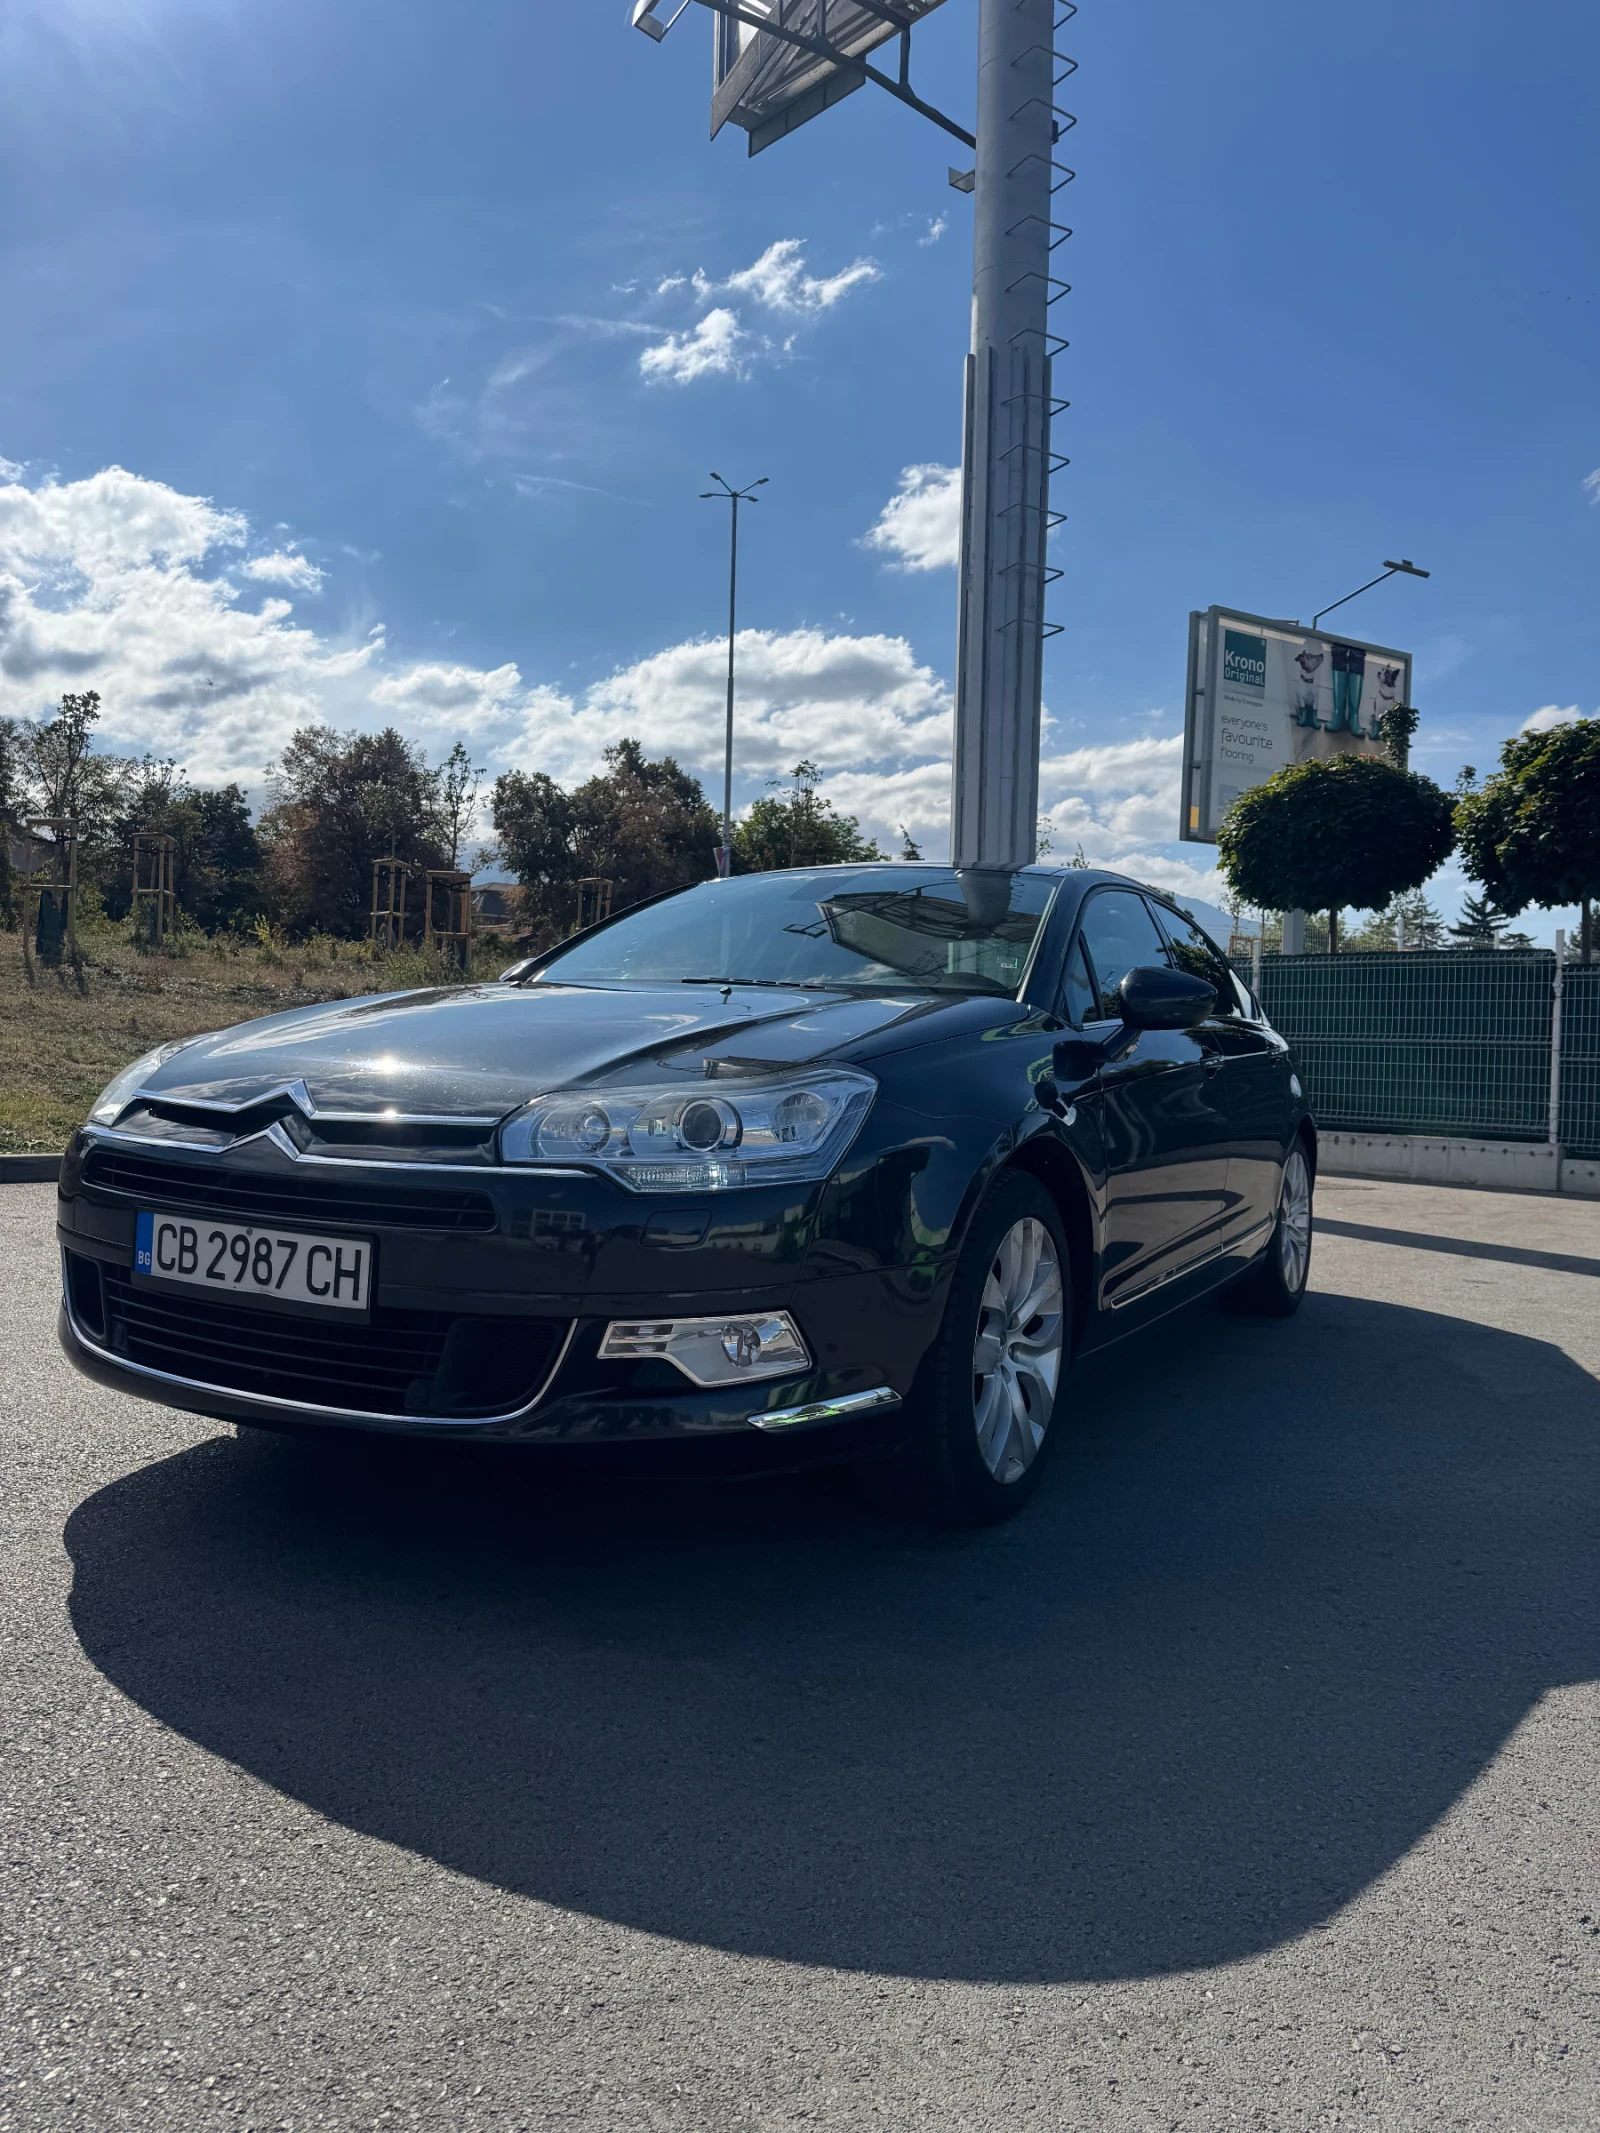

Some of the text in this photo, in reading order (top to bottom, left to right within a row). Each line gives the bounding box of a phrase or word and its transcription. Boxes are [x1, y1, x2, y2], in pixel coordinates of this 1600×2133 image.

[1225, 649, 1265, 673] Krono
[1225, 667, 1264, 685] Original
[1236, 695, 1242, 704] by
[1221, 715, 1268, 732] everyone's
[1221, 727, 1273, 749] favourite
[1220, 746, 1254, 764] flooring
[138, 1250, 151, 1266] BG
[156, 1223, 362, 1302] CB 2987 CH
